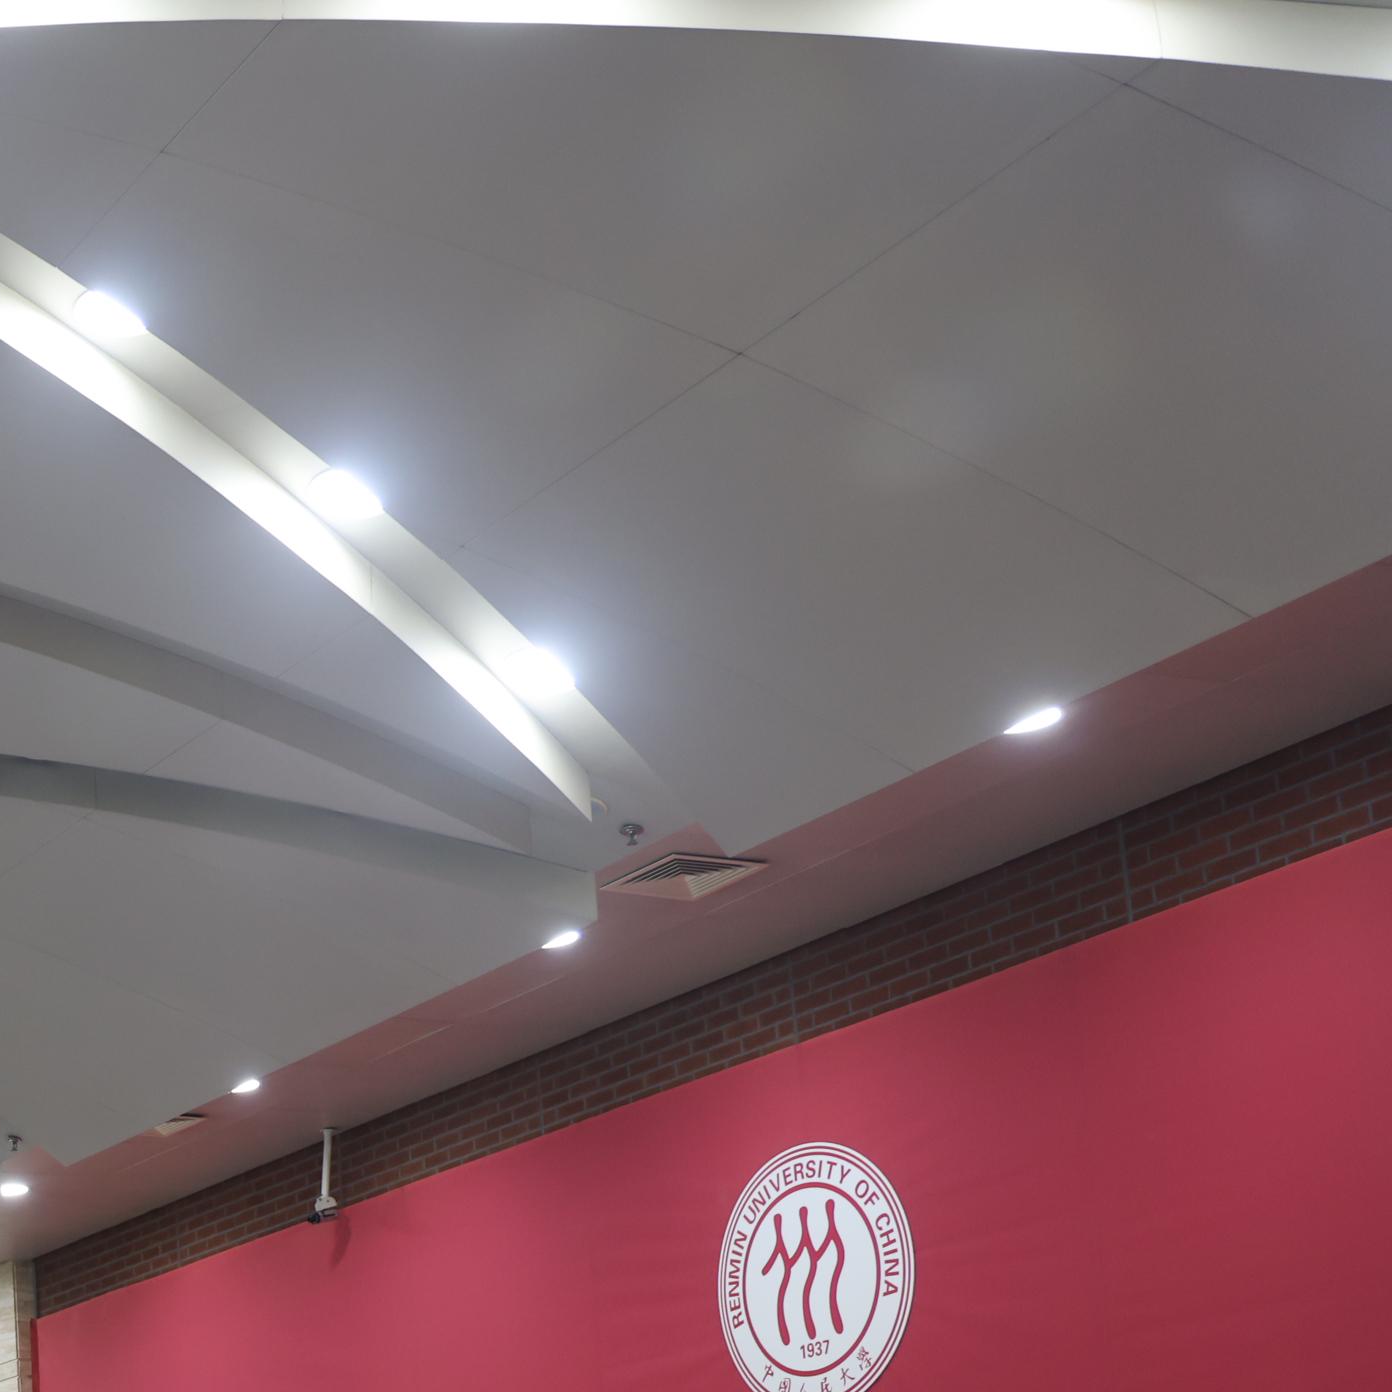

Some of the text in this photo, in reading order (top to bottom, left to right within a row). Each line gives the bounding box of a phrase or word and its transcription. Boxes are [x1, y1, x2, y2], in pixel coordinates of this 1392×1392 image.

[728, 1159, 900, 1329] RENMIN UNIVERSITY OF CHINA
[799, 1340, 831, 1360] 1937
